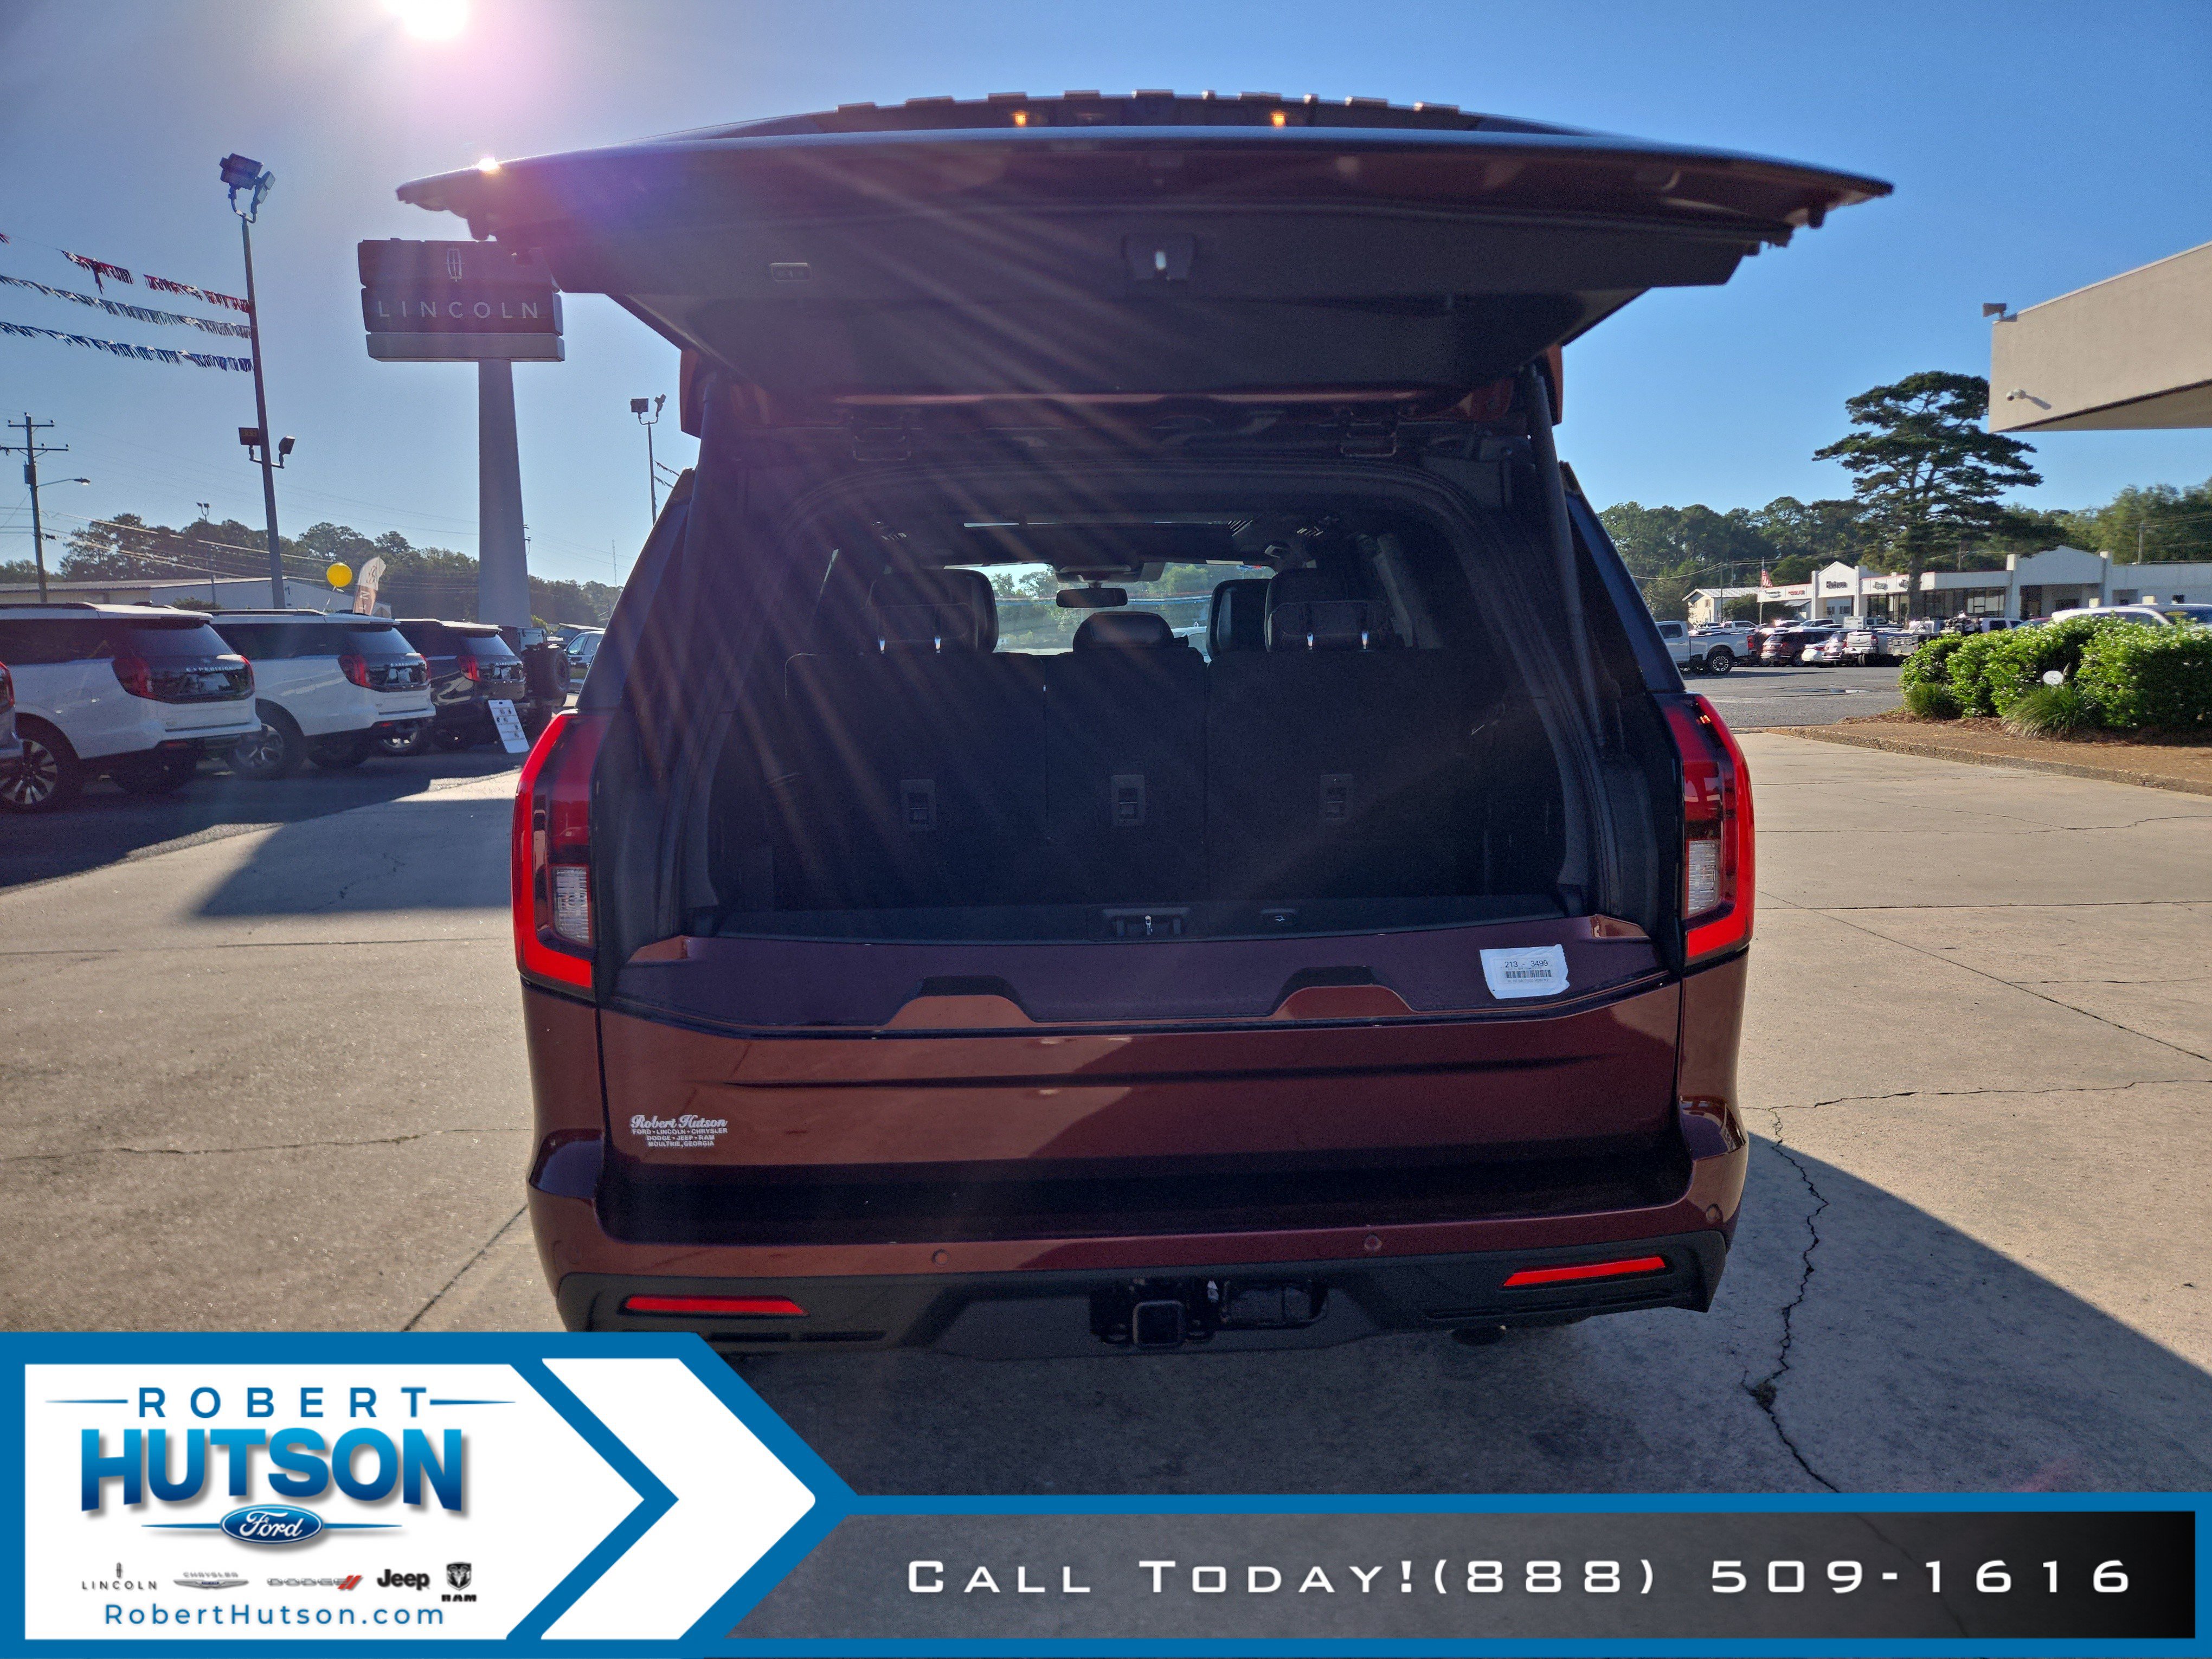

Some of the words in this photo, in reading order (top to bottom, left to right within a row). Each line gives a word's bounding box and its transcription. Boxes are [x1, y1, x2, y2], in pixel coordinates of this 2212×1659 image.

[378, 300, 538, 319] LINCOLN
[630, 1115, 677, 1128] Robert
[678, 1114, 728, 1128] Hutson
